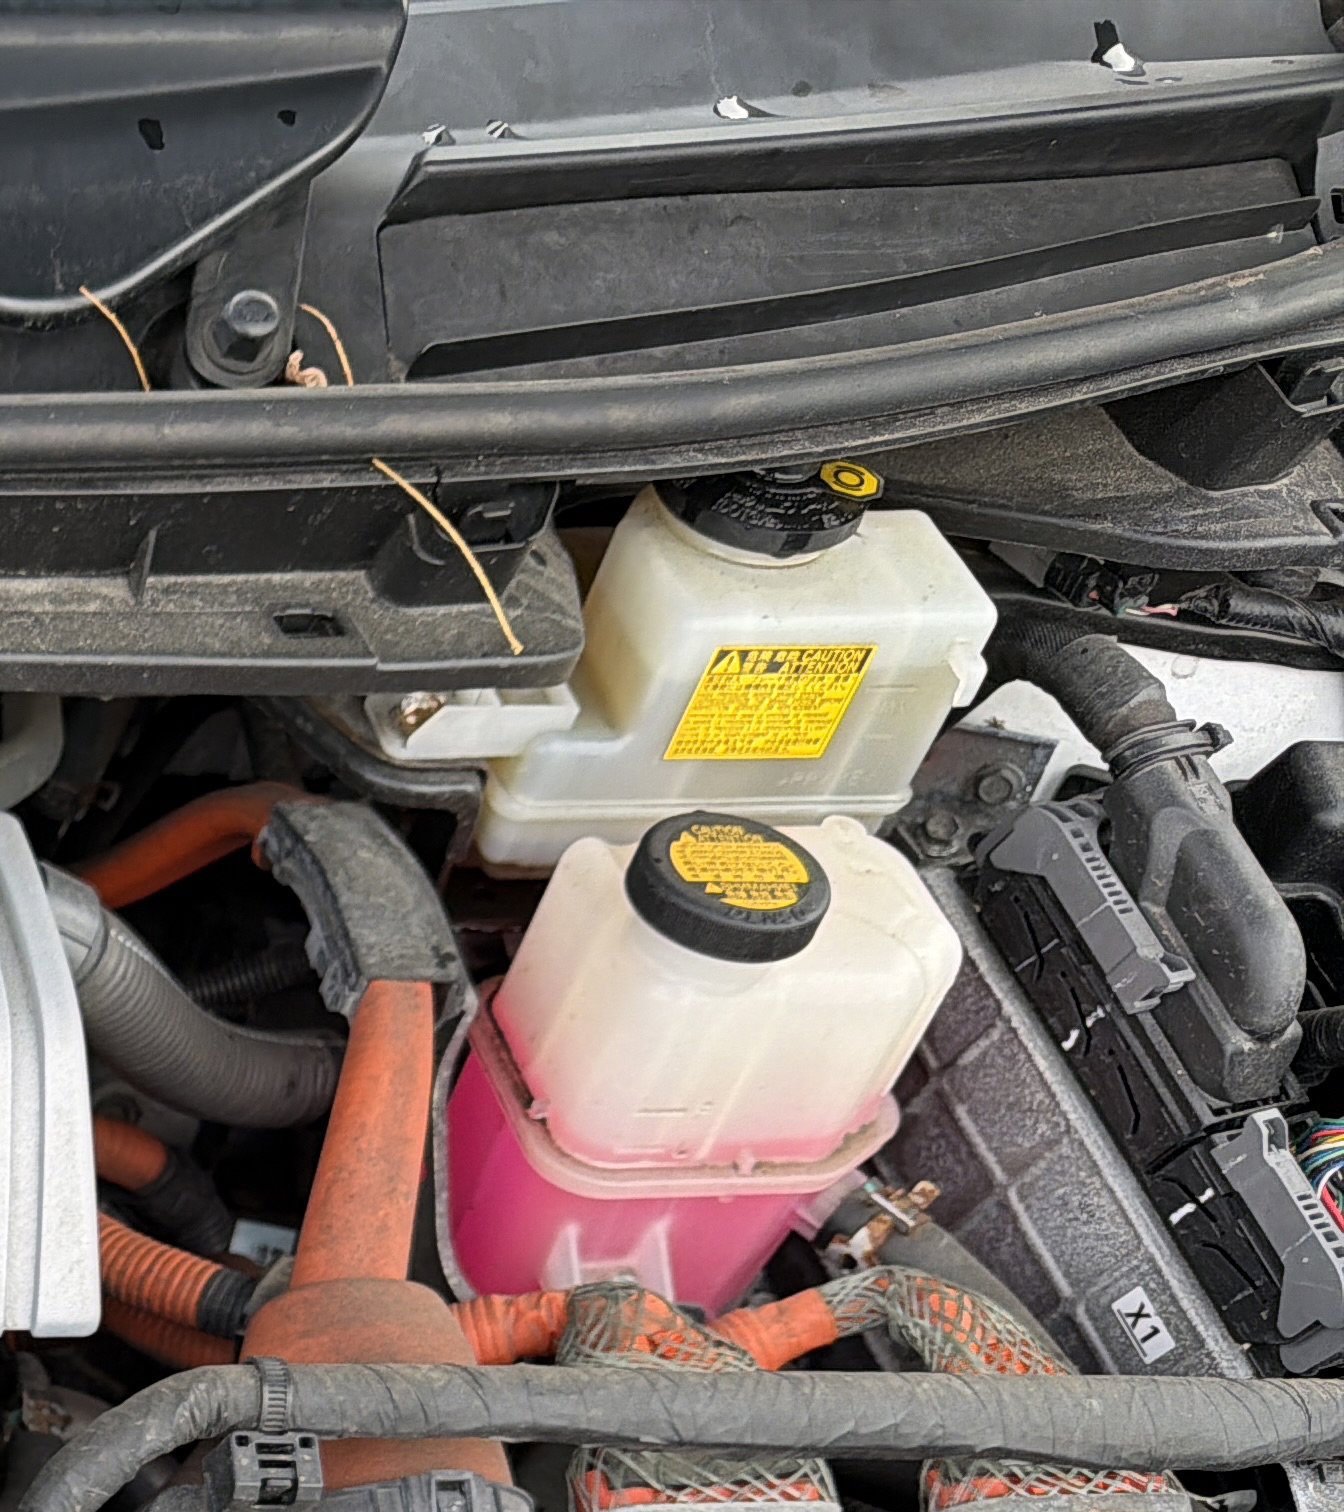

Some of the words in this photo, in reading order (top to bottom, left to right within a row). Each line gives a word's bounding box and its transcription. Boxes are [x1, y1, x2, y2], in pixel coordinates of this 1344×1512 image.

[802, 650, 865, 662] CAUTION
[778, 662, 858, 674] ATTENTION
[1124, 1301, 1161, 1344] X1
